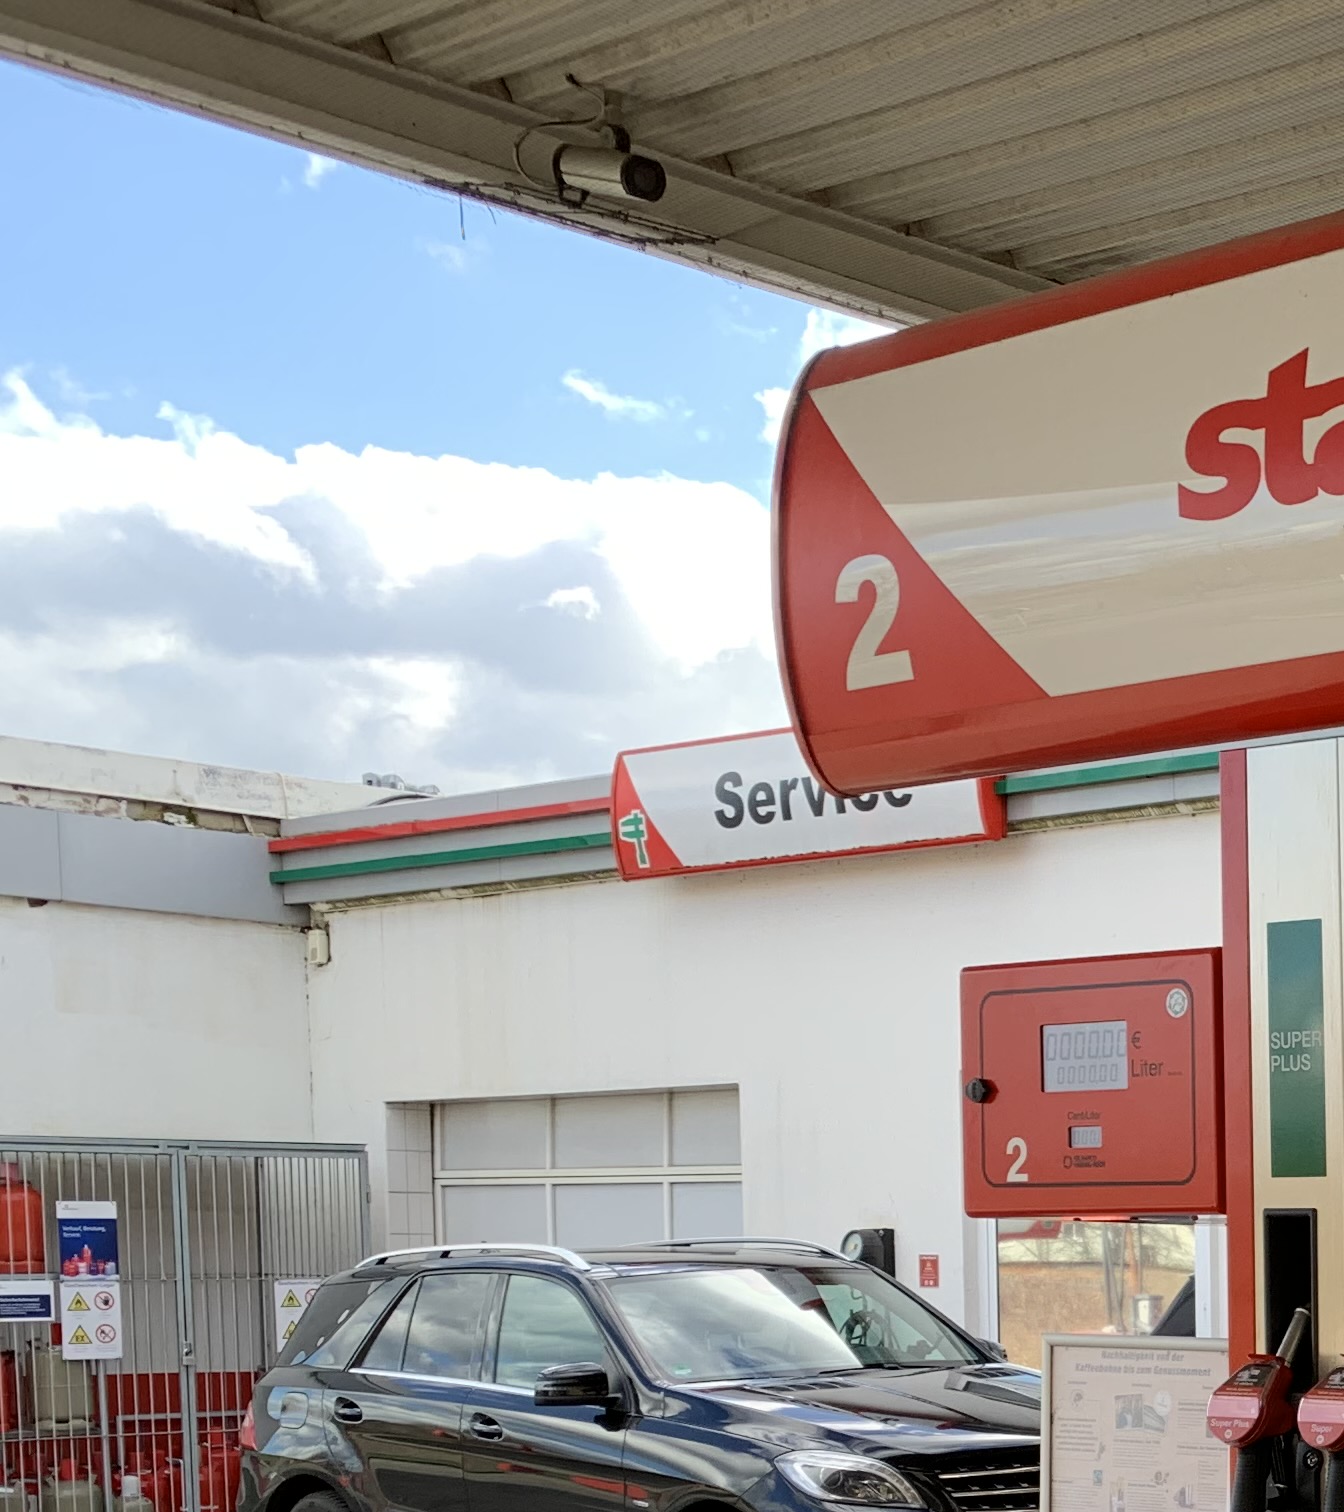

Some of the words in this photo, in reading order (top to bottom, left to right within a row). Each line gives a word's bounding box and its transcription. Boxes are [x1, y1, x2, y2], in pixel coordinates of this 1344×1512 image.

[834, 554, 915, 692] 2
[1270, 1030, 1322, 1050] SUPER
[1131, 1059, 1164, 1078] Liter
[1270, 1054, 1311, 1072] PLUS
[1006, 1137, 1029, 1183] 2
[1123, 1365, 1135, 1374] bis
[1210, 1418, 1233, 1429] Super
[1311, 1423, 1333, 1434] Super
